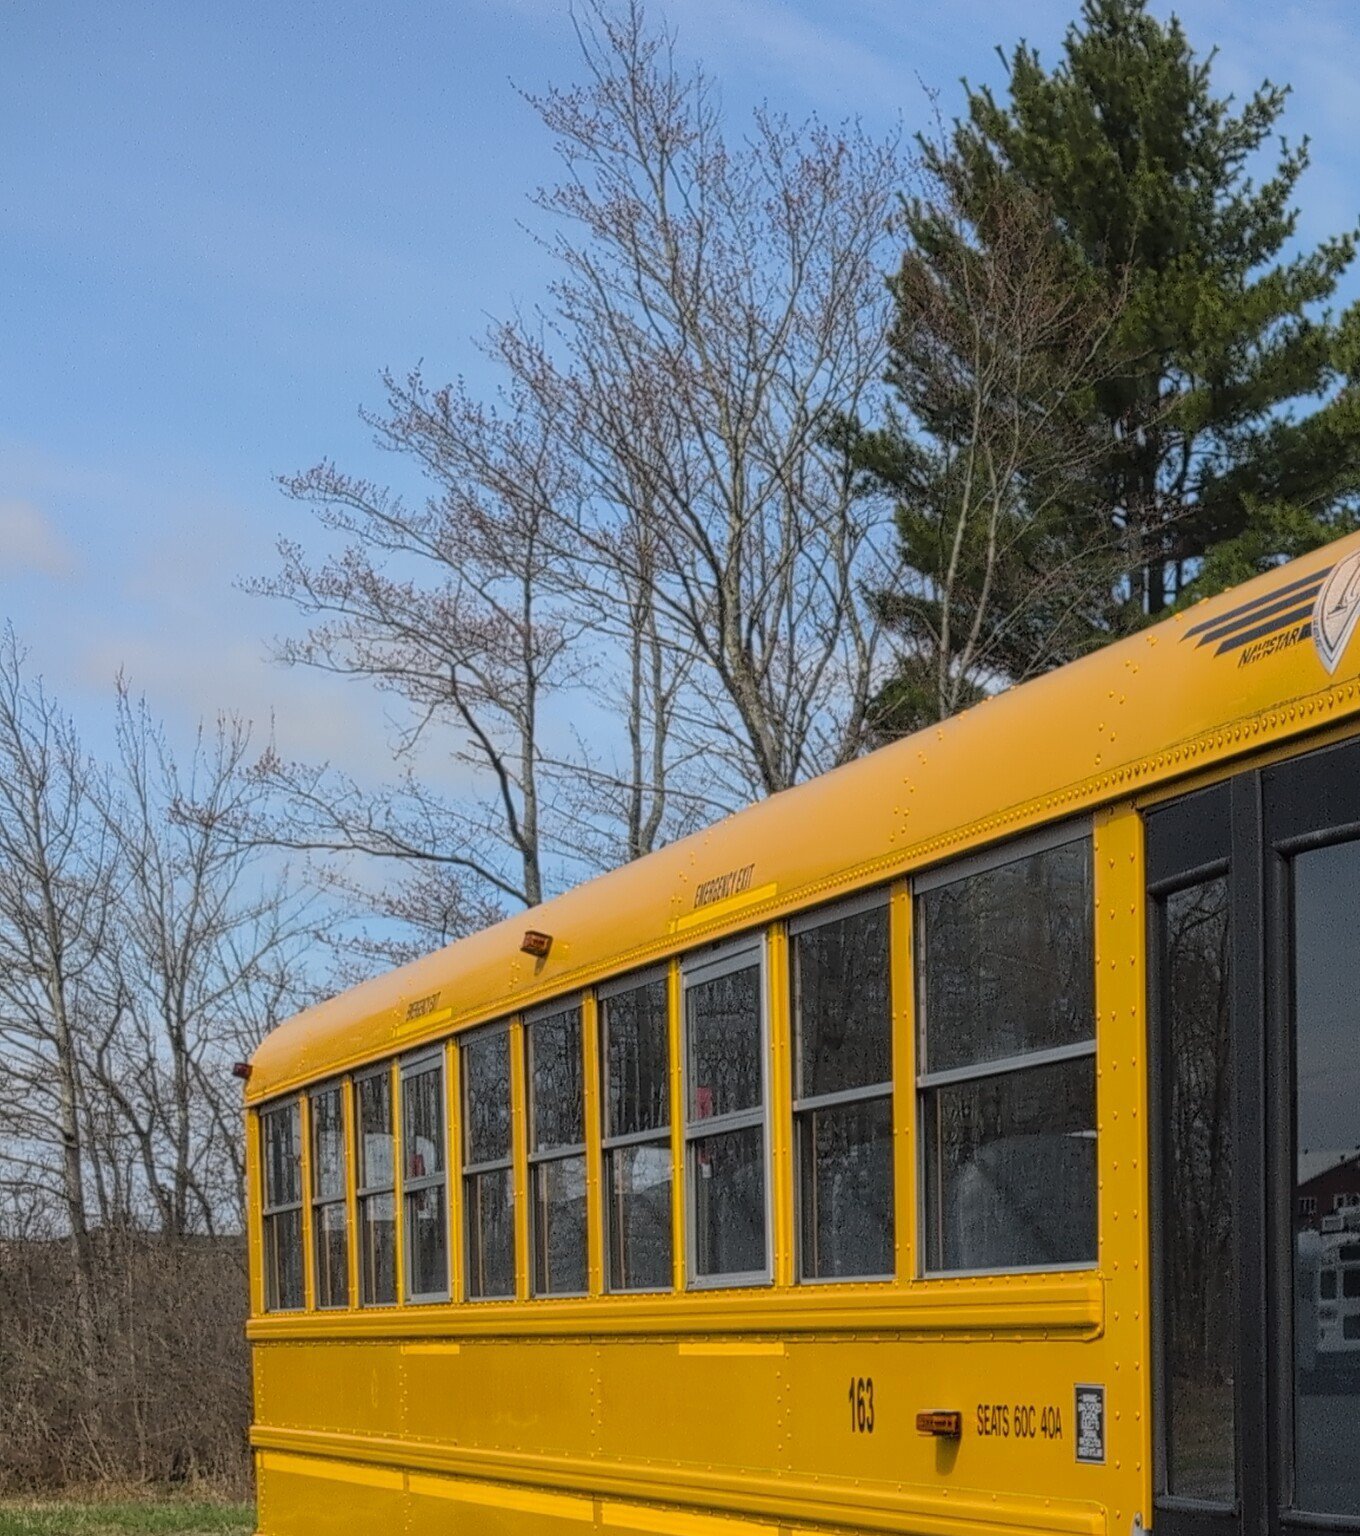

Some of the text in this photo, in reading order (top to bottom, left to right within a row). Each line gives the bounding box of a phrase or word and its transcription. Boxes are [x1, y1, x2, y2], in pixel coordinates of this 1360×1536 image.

[849, 1376, 874, 1434] 163
[976, 1403, 1010, 1438] SEATS
[1014, 1404, 1036, 1439] 60C
[1041, 1405, 1063, 1440] 40A
